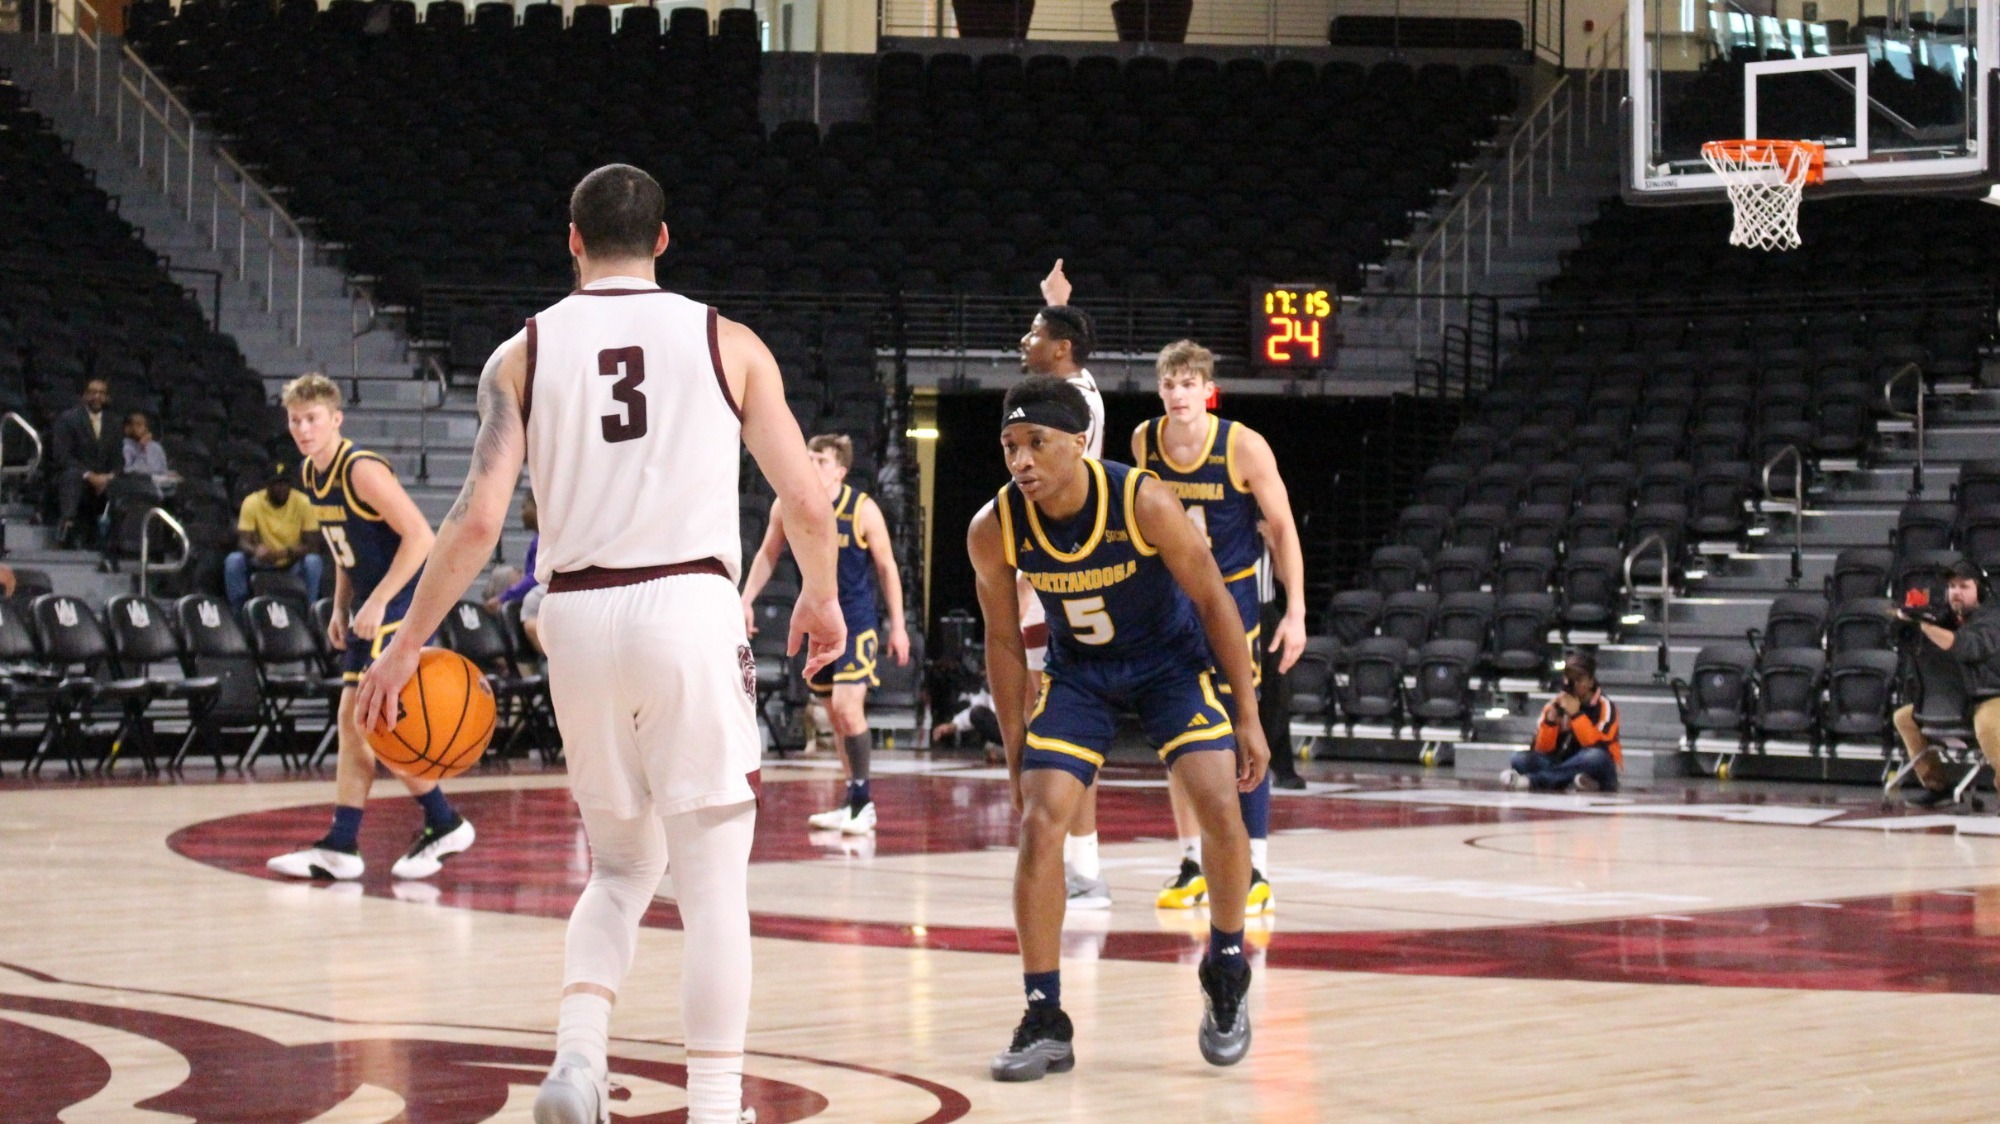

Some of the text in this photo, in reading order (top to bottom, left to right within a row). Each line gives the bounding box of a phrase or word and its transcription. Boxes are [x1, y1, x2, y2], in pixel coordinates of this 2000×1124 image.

[1265, 290, 1330, 317] 17:15
[1268, 317, 1319, 360] 24
[598, 345, 647, 443] 3
[322, 526, 355, 568] 13
[1062, 596, 1115, 645] 5
